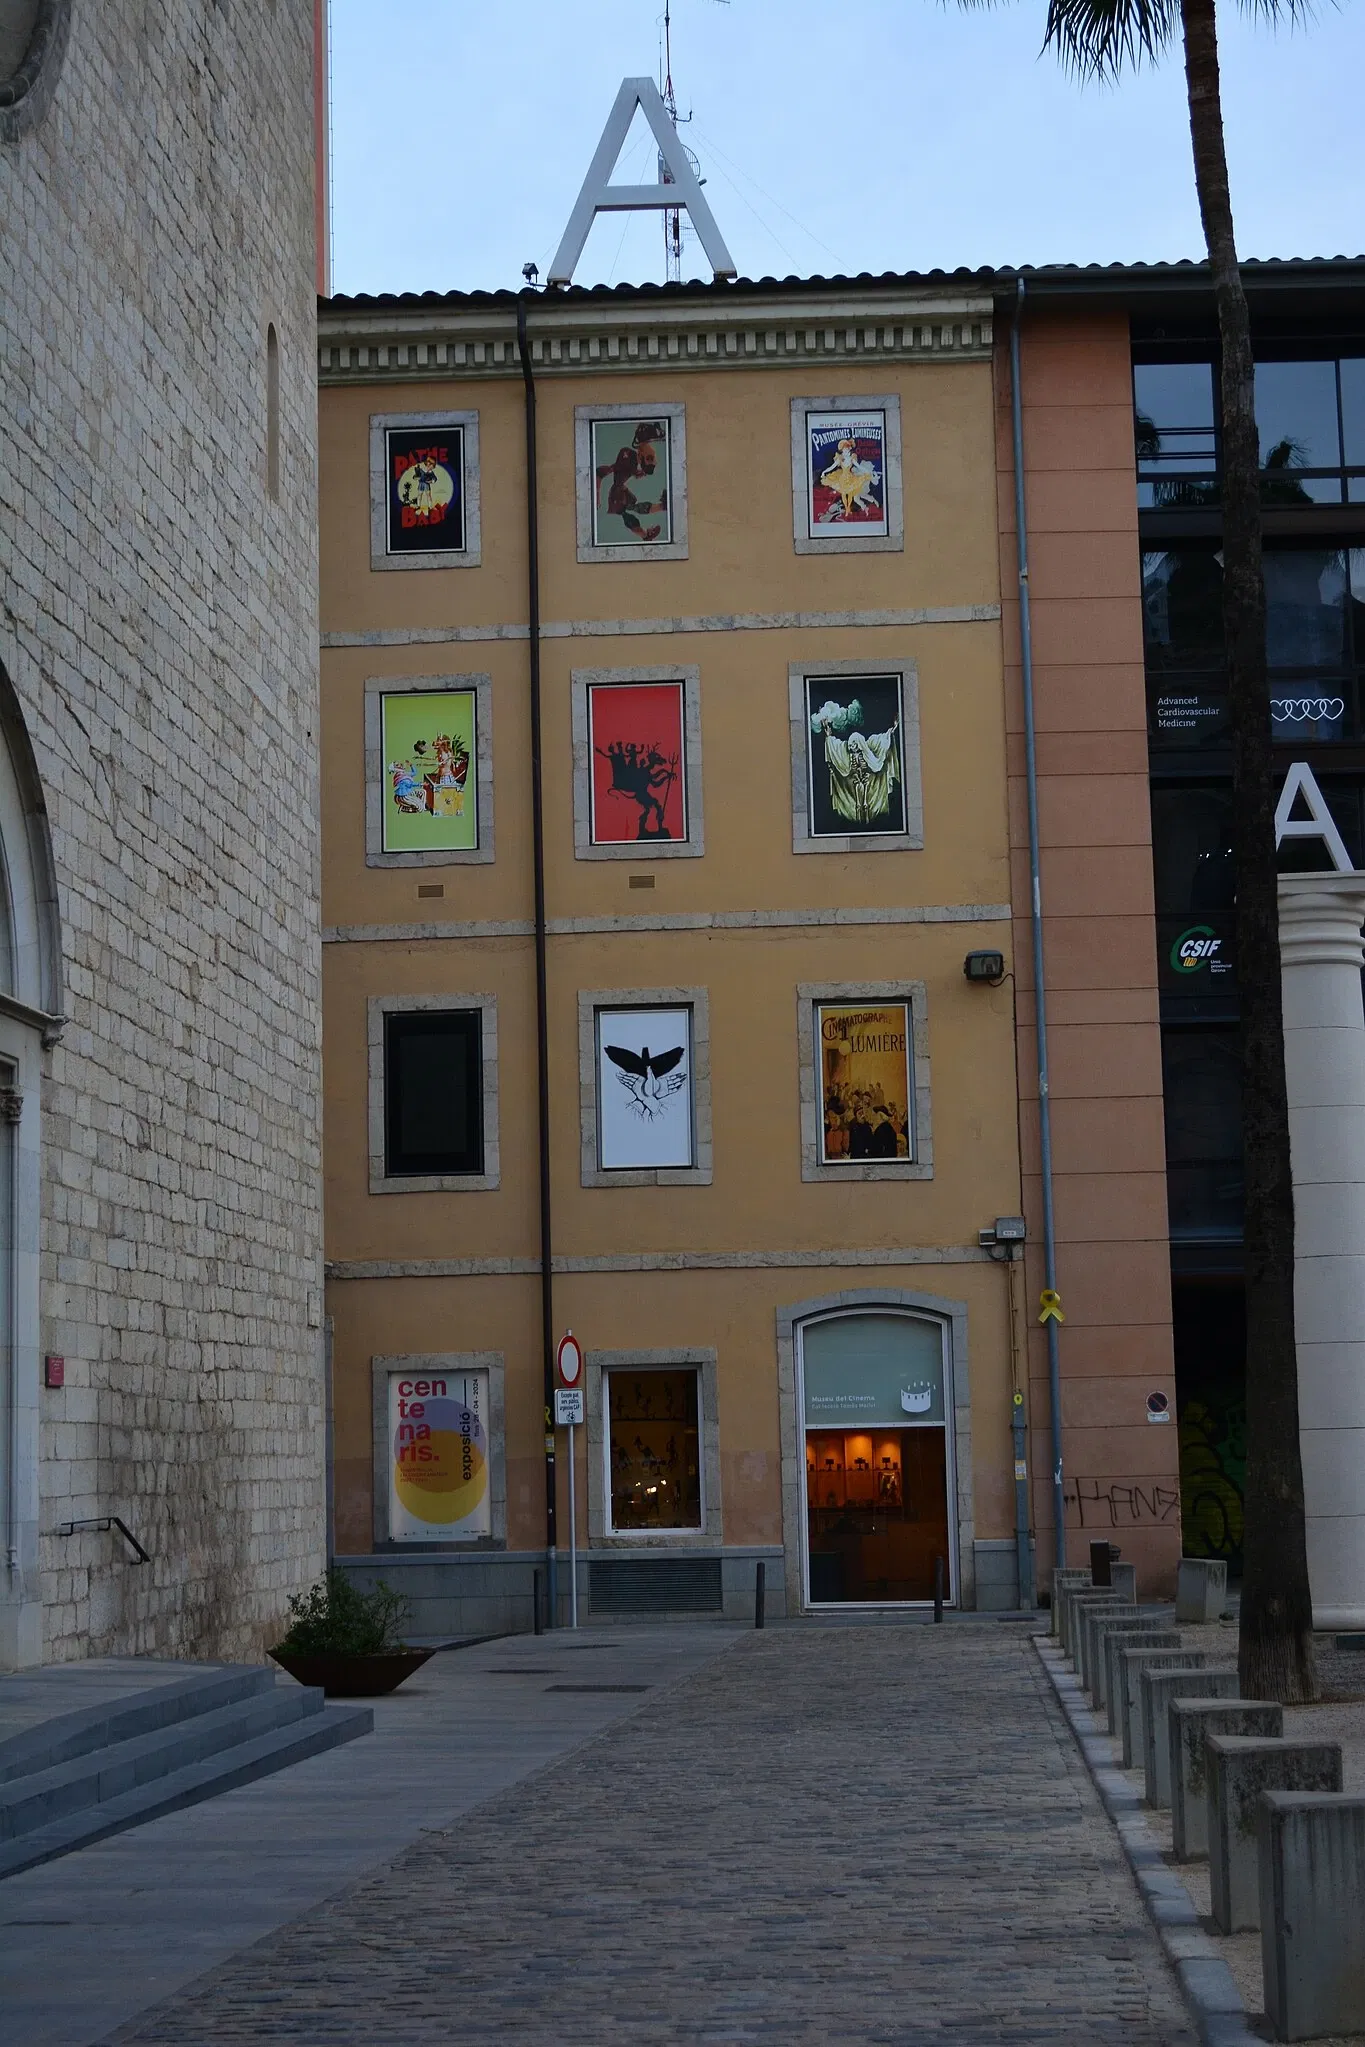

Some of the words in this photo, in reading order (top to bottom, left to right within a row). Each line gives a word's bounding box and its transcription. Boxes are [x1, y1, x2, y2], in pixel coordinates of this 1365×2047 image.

[547, 77, 738, 282] A
[402, 503, 448, 528] BABY
[1157, 696, 1198, 706] Advanced
[1157, 707, 1220, 717] Cardiovascular
[1158, 718, 1197, 728] Medicine
[1275, 761, 1355, 873] A
[1180, 939, 1222, 958] CSIF
[851, 1032, 906, 1052] LUMIÈRE
[398, 1377, 447, 1398] cen
[398, 1399, 425, 1418] te
[399, 1422, 431, 1441] na
[399, 1441, 440, 1463] ris.
[460, 1411, 473, 1480] exposició
